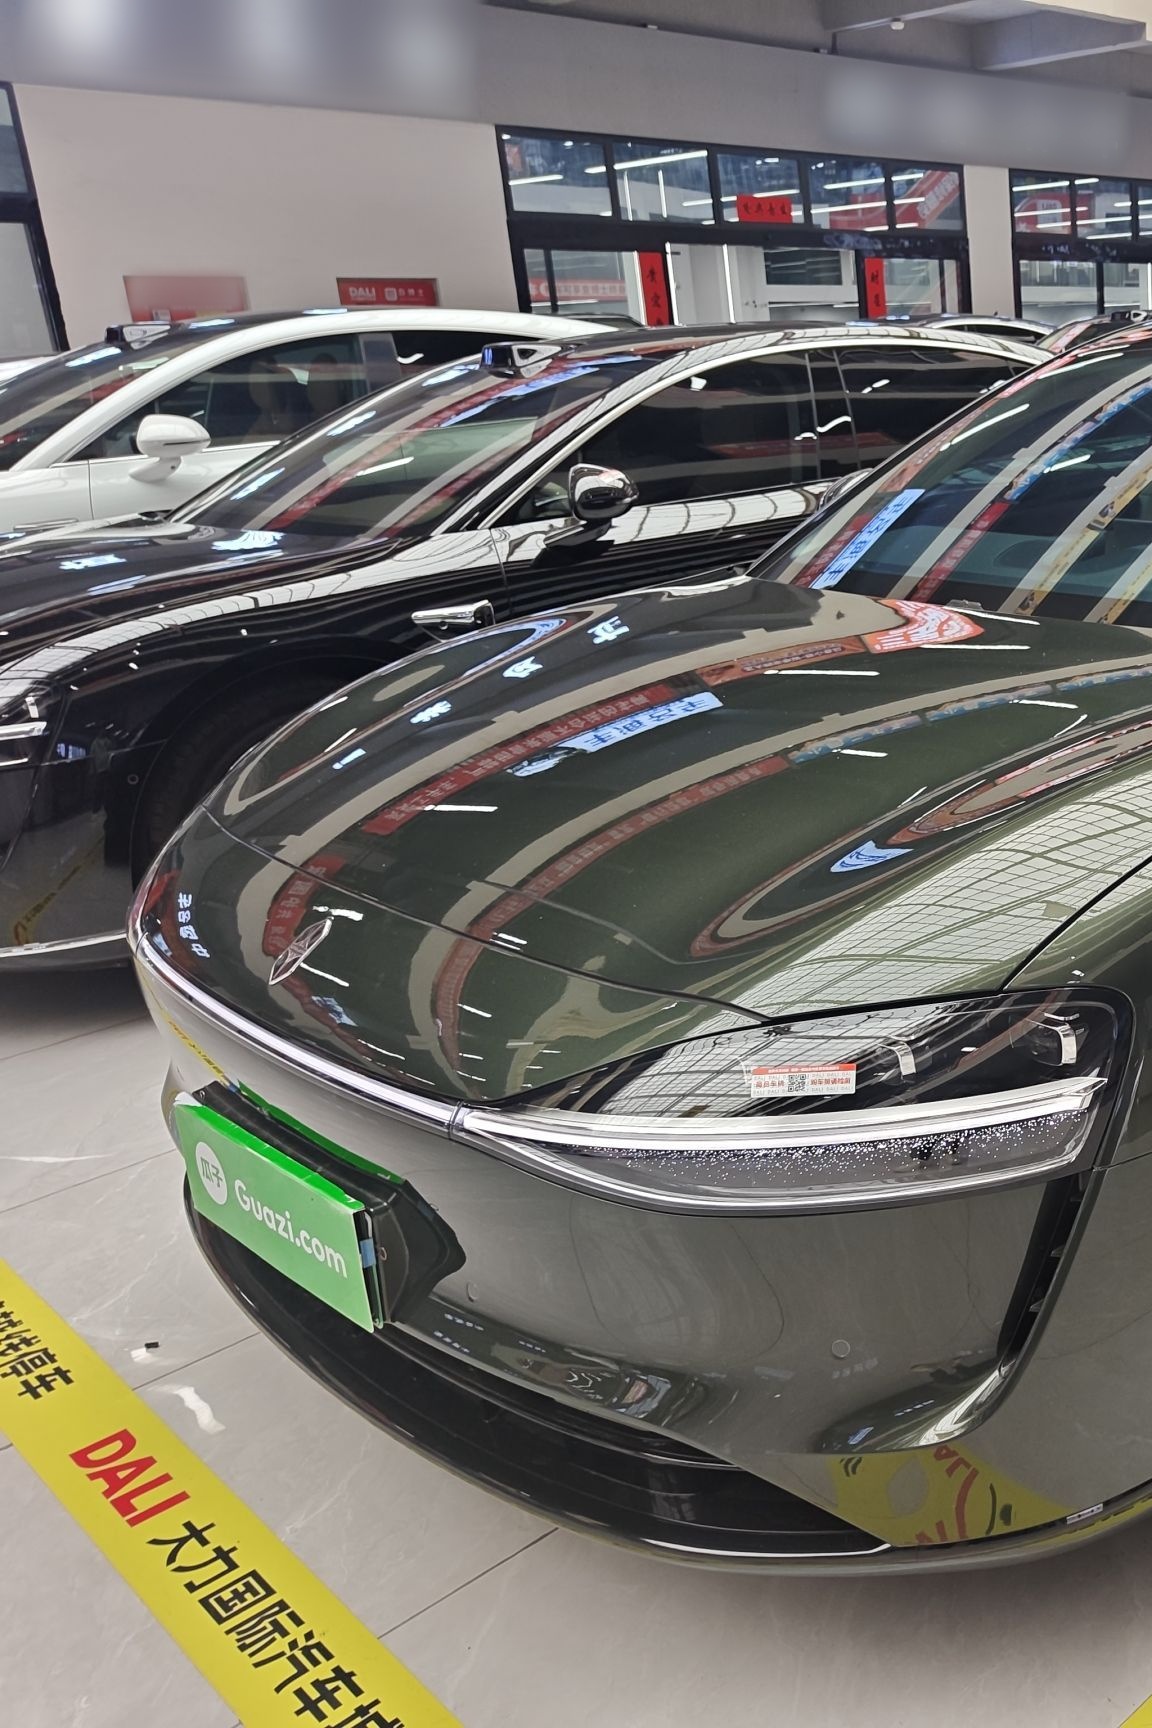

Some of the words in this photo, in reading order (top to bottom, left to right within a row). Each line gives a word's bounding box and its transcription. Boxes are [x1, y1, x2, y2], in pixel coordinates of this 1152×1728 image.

[199, 1156, 224, 1189] 瓜子
[234, 1179, 348, 1280] Guazi.com
[69, 1428, 191, 1528] DALI
